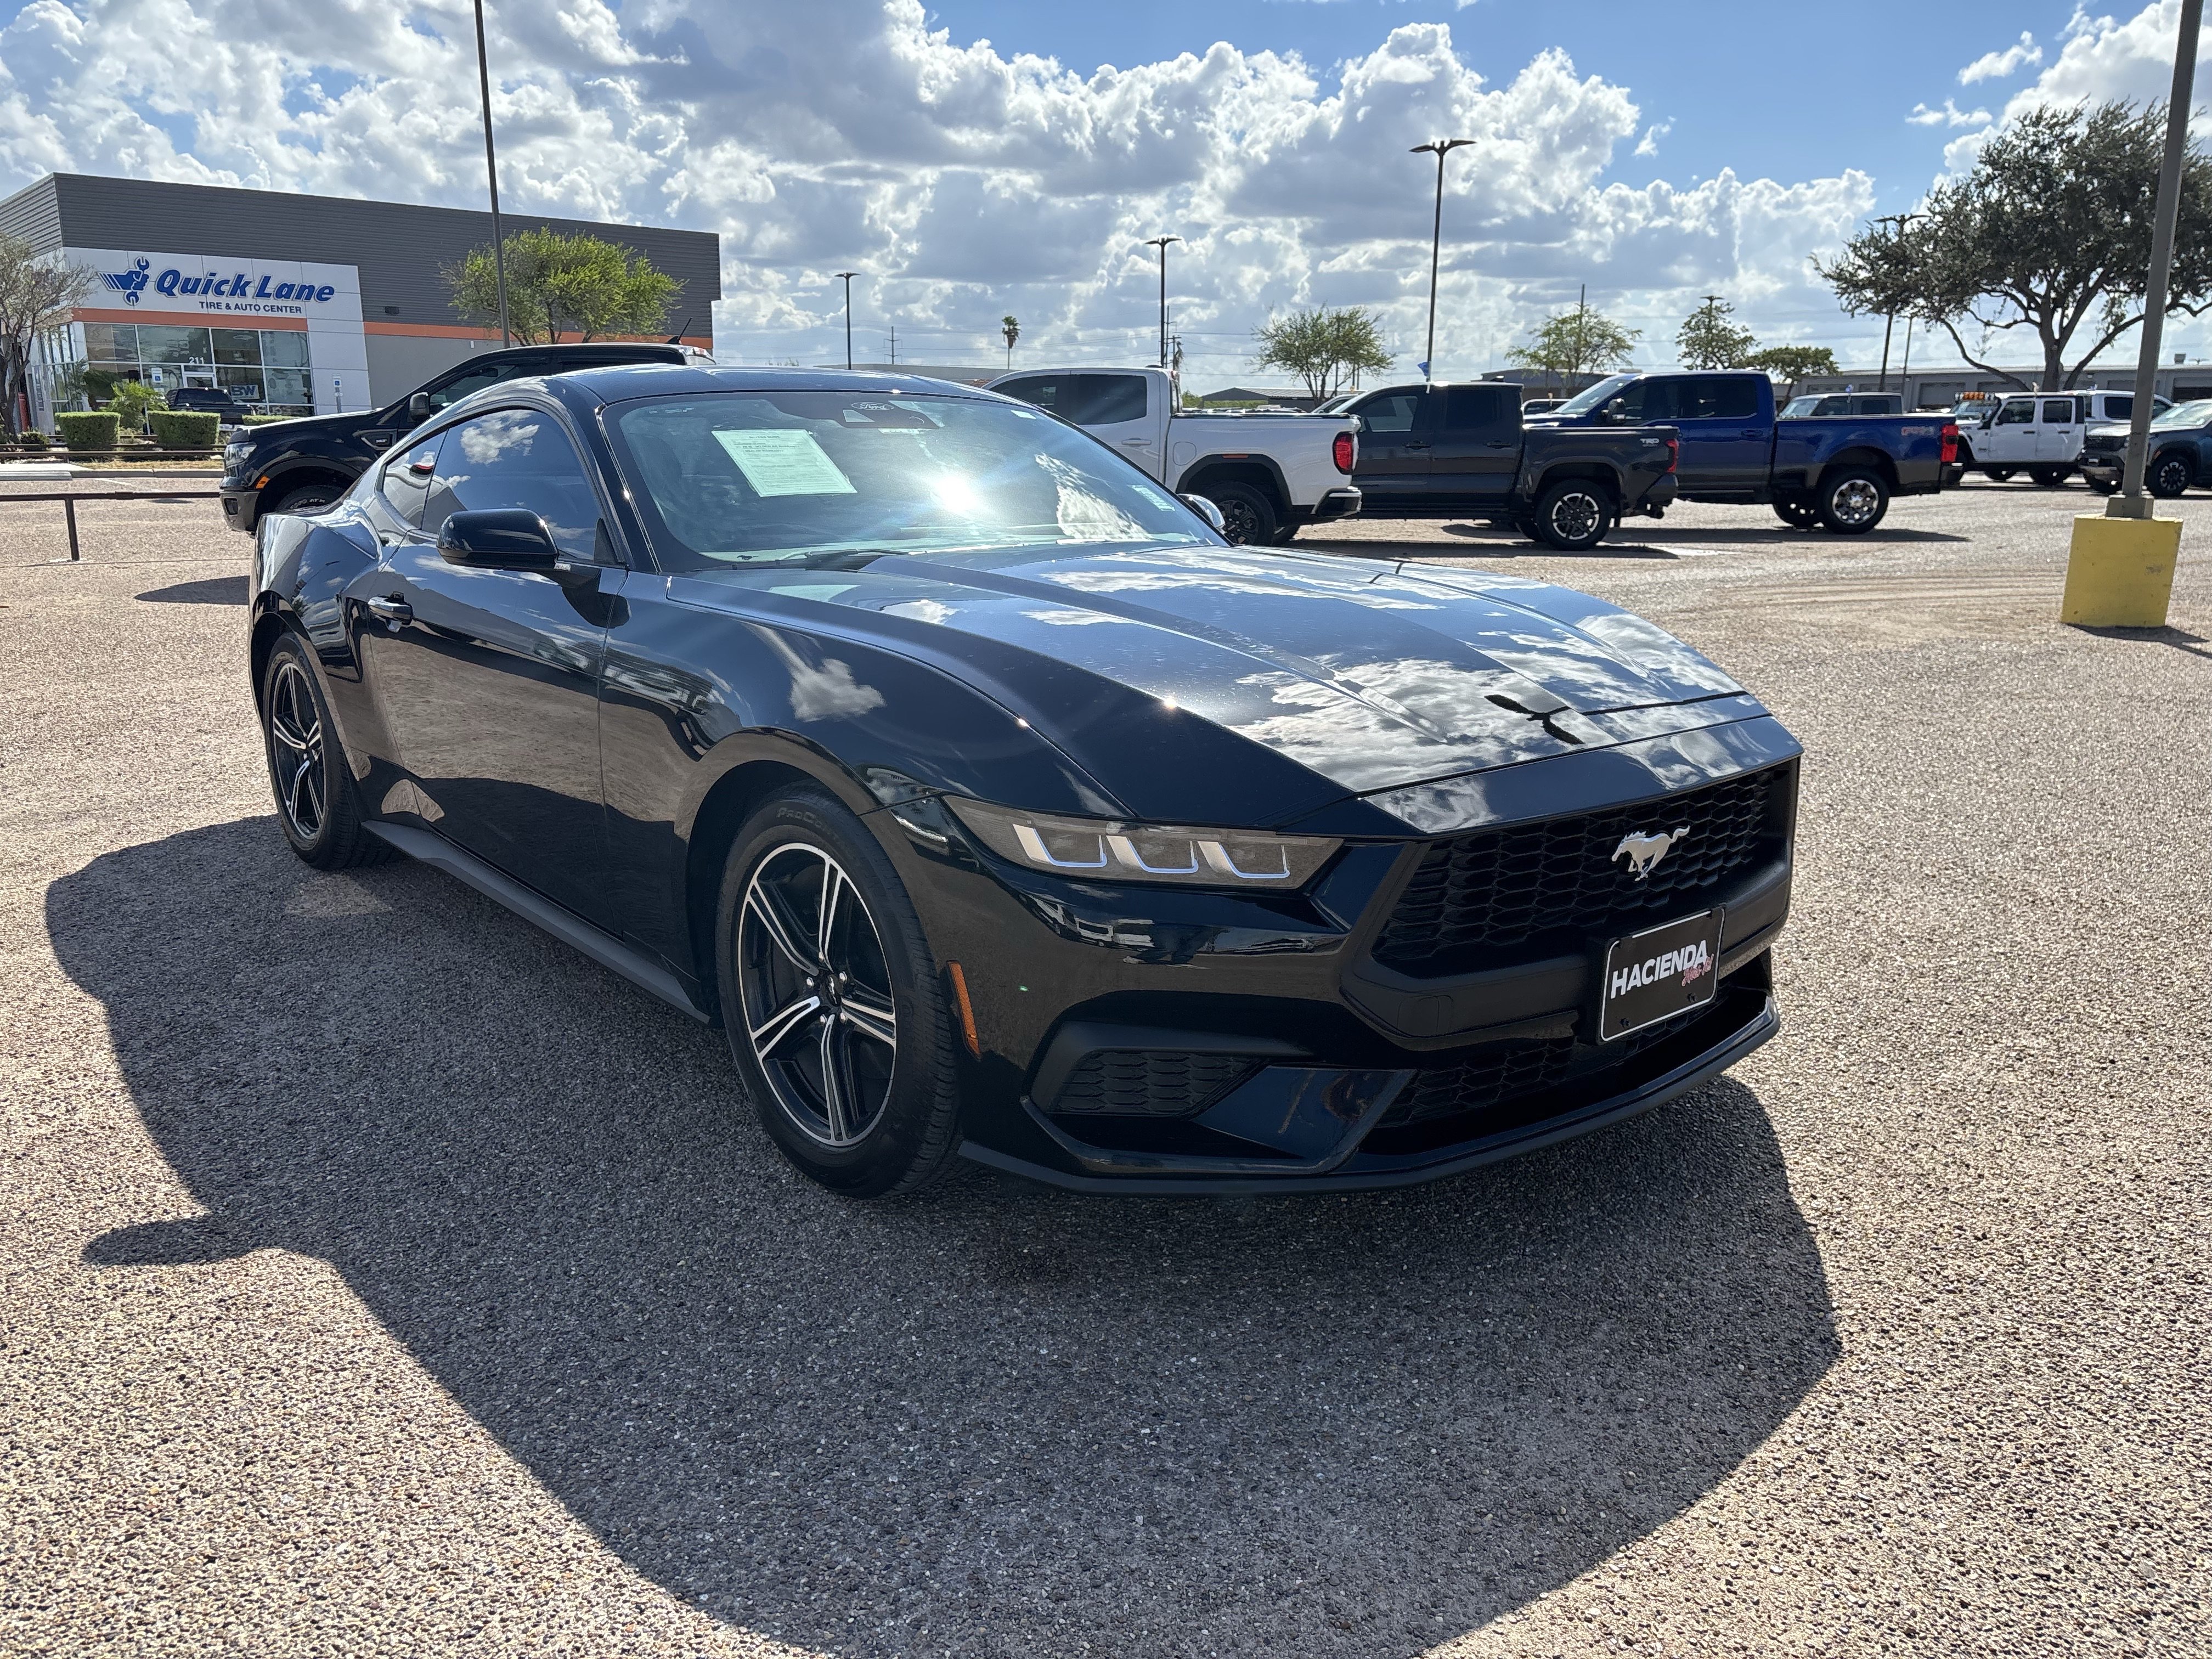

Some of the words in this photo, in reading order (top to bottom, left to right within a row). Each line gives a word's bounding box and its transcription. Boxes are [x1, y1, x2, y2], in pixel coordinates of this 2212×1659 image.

[156, 269, 252, 297] Quick
[255, 275, 335, 302] Lane
[199, 301, 223, 310] TIRE
[234, 303, 261, 312] AUTO
[263, 304, 302, 314] CENTER
[1611, 939, 1707, 1000] HACIENDA
